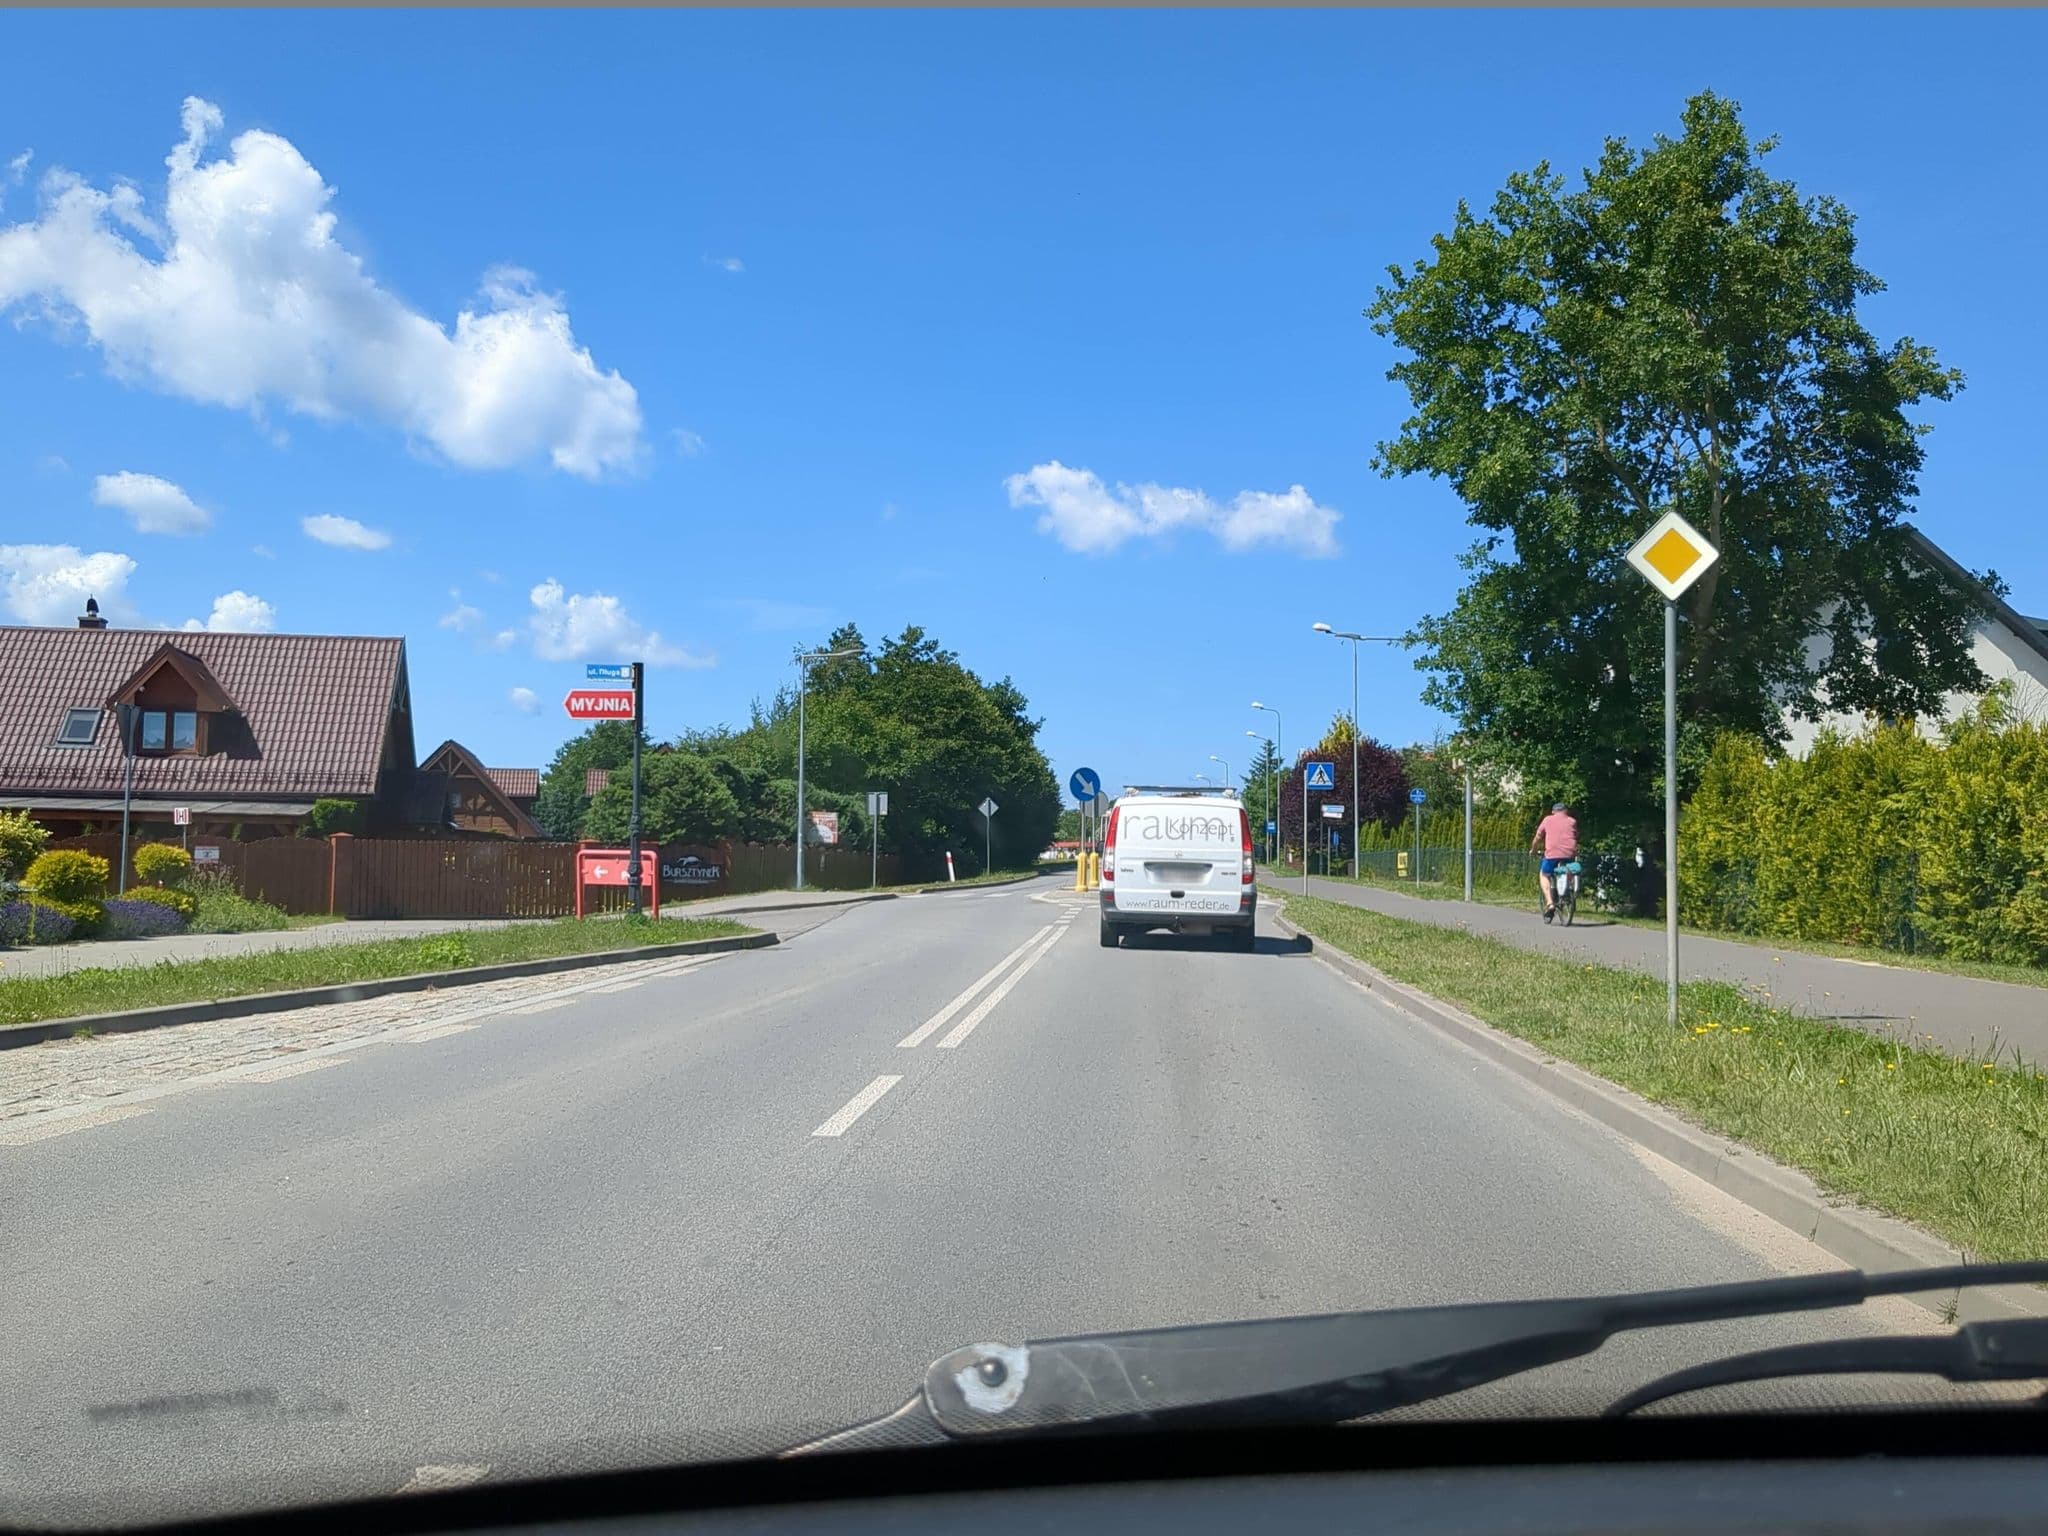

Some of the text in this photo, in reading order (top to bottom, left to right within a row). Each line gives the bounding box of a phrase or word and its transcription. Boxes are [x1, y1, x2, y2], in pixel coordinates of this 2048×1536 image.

[571, 697, 630, 712] MYJNIA
[1124, 815, 1225, 842] raum
[1169, 818, 1234, 840] Konzept
[1126, 898, 1230, 911] www.raum-reder.de
